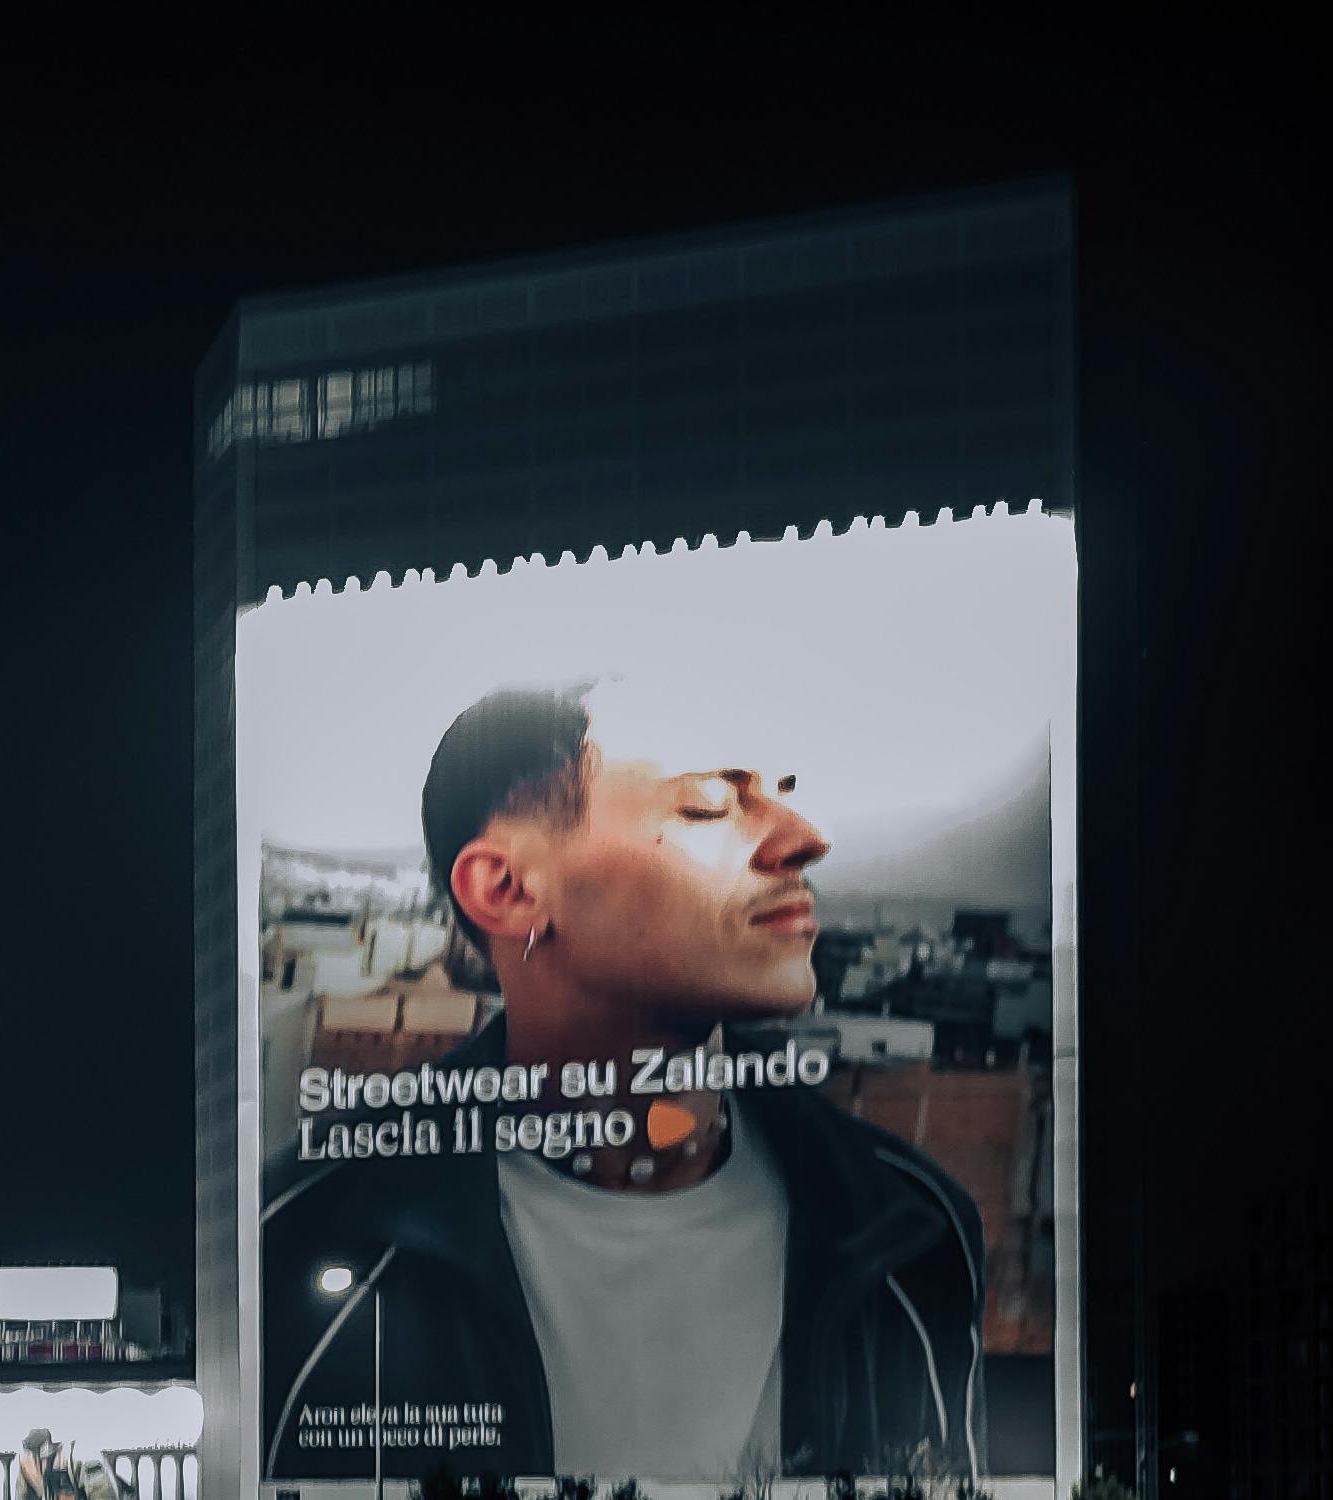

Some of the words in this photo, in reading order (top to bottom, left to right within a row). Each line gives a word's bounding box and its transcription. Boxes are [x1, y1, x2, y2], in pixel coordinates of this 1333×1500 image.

[299, 1062, 548, 1112] Streetwear
[560, 1058, 617, 1098] su
[630, 1038, 830, 1094] Zalando
[297, 1110, 441, 1160] Lascia
[452, 1105, 482, 1154] il
[495, 1109, 634, 1159] segno
